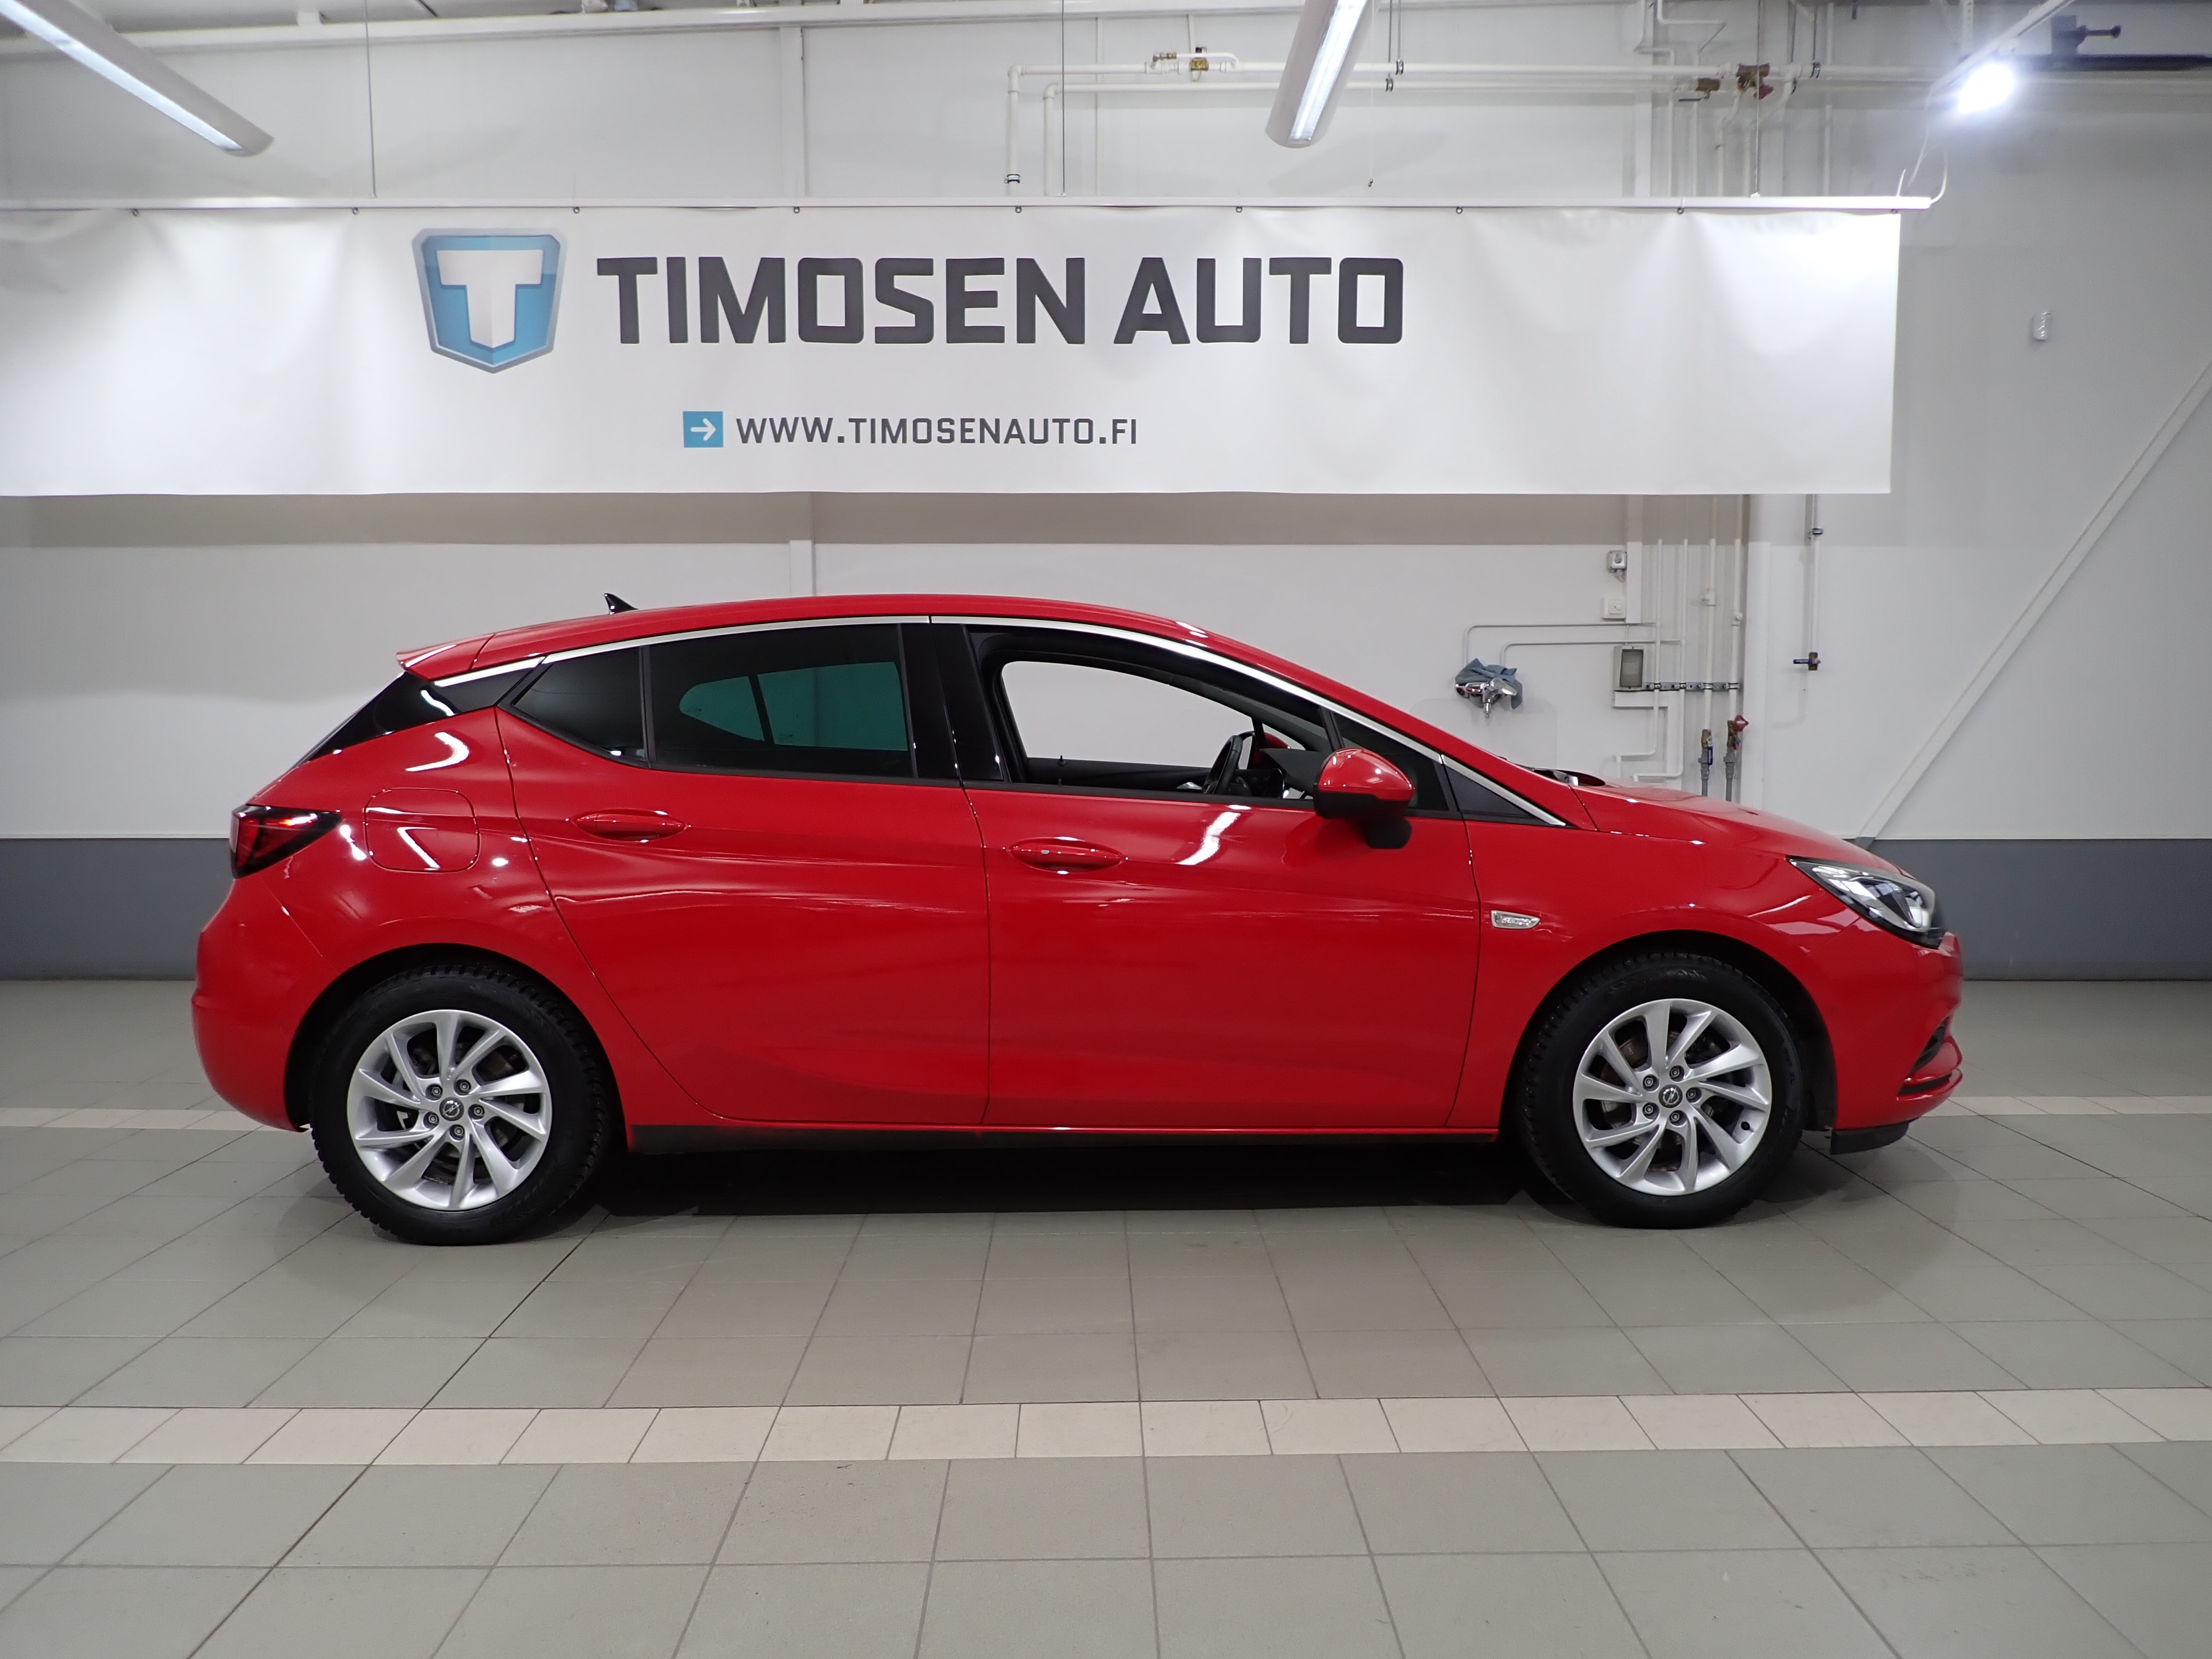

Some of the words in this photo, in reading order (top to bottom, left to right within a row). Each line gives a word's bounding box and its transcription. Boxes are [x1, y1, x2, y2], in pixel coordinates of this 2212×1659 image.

[436, 249, 544, 348] T
[597, 257, 1085, 344] TIMOSEN
[1113, 257, 1404, 344] AUTO
[736, 416, 1136, 444] WWW.TIMOSENAUTO.FI
